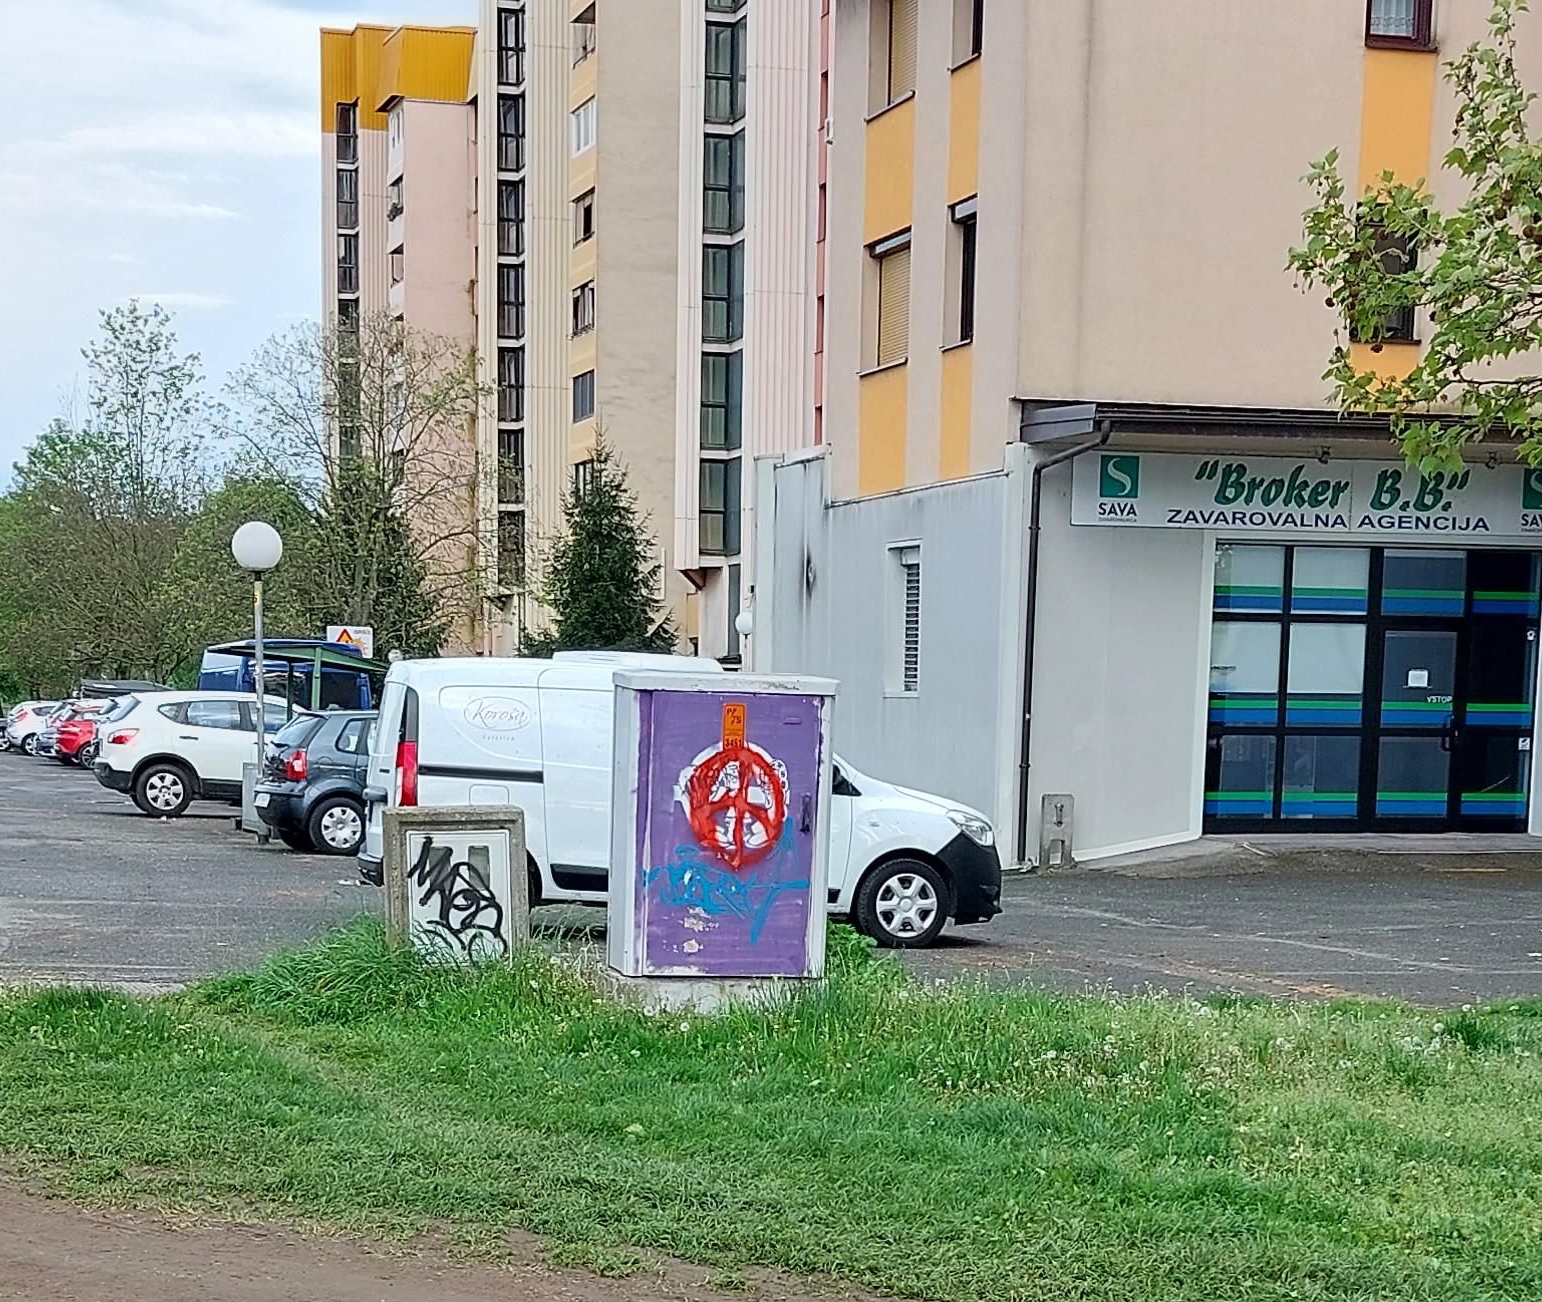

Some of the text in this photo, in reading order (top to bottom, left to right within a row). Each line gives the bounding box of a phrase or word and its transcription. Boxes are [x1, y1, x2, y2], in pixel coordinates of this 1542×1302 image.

[1098, 502, 1138, 517] SAVA
[1166, 508, 1491, 532] ZAVAROVALNA AGENCIJA
[1426, 695, 1453, 703] VSTOP
